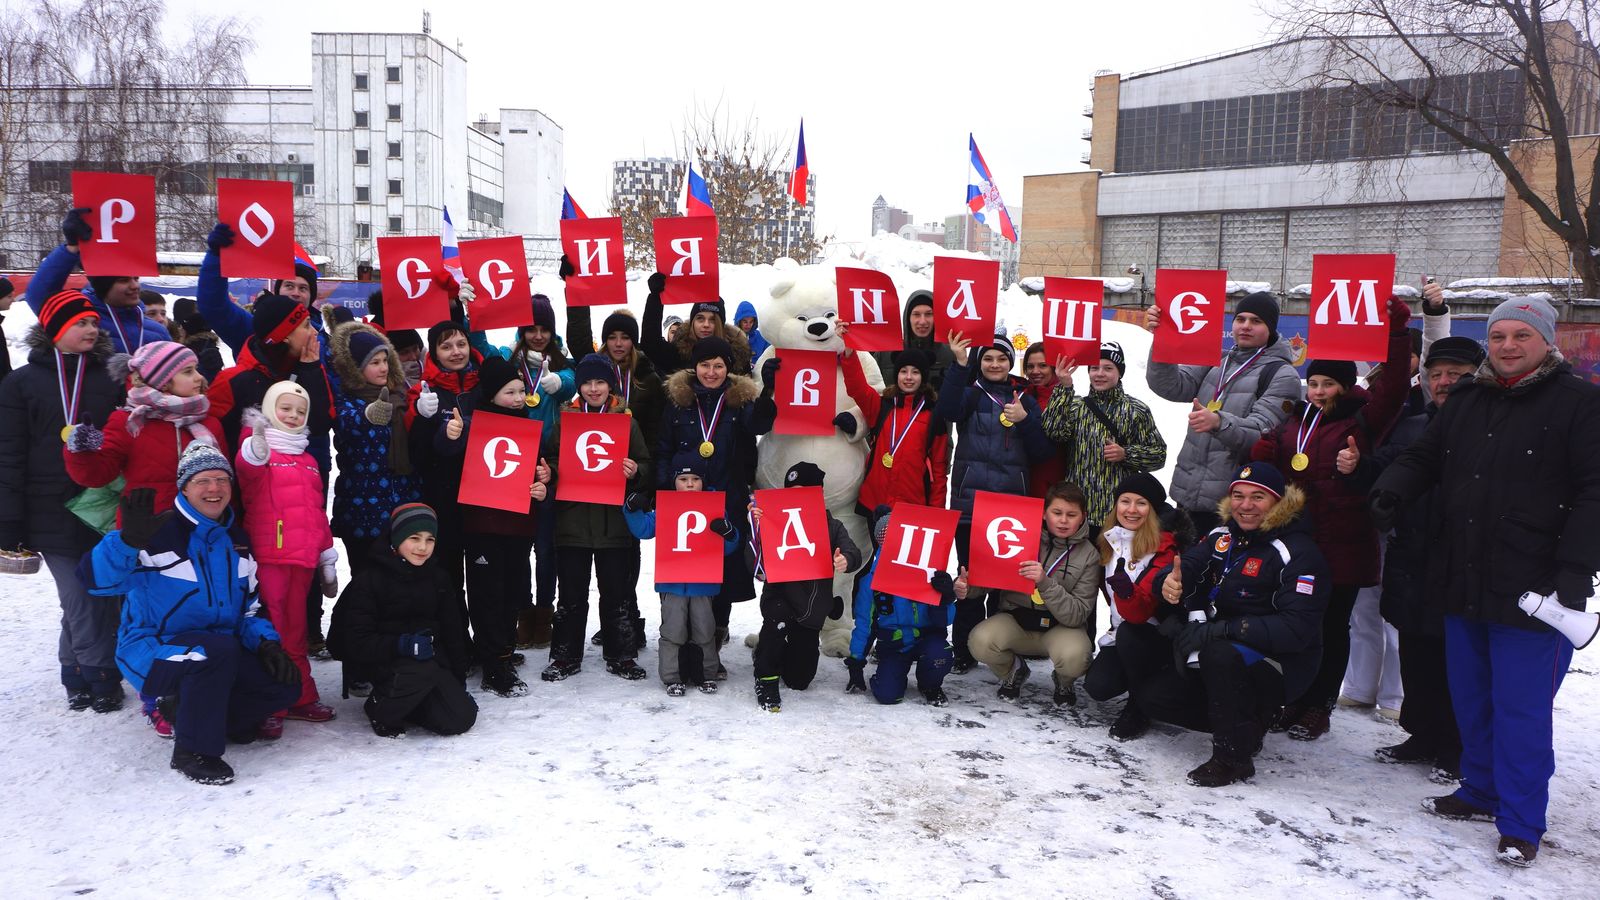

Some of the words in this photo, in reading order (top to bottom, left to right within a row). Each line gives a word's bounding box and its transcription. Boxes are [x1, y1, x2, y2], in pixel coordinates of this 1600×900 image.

[97, 199, 135, 243] Р
[238, 202, 275, 248] О
[574, 238, 613, 277] И
[669, 237, 706, 277] Я
[396, 258, 433, 299] С
[478, 259, 515, 301] С
[343, 300, 368, 309] ГЕОГ
[946, 279, 982, 321] А
[1045, 298, 1098, 341] Ш
[1314, 279, 1385, 326] М
[789, 368, 820, 407] В
[482, 436, 522, 478] С
[672, 511, 708, 552] Р
[776, 508, 816, 561] Д
[891, 524, 940, 583] Ц
